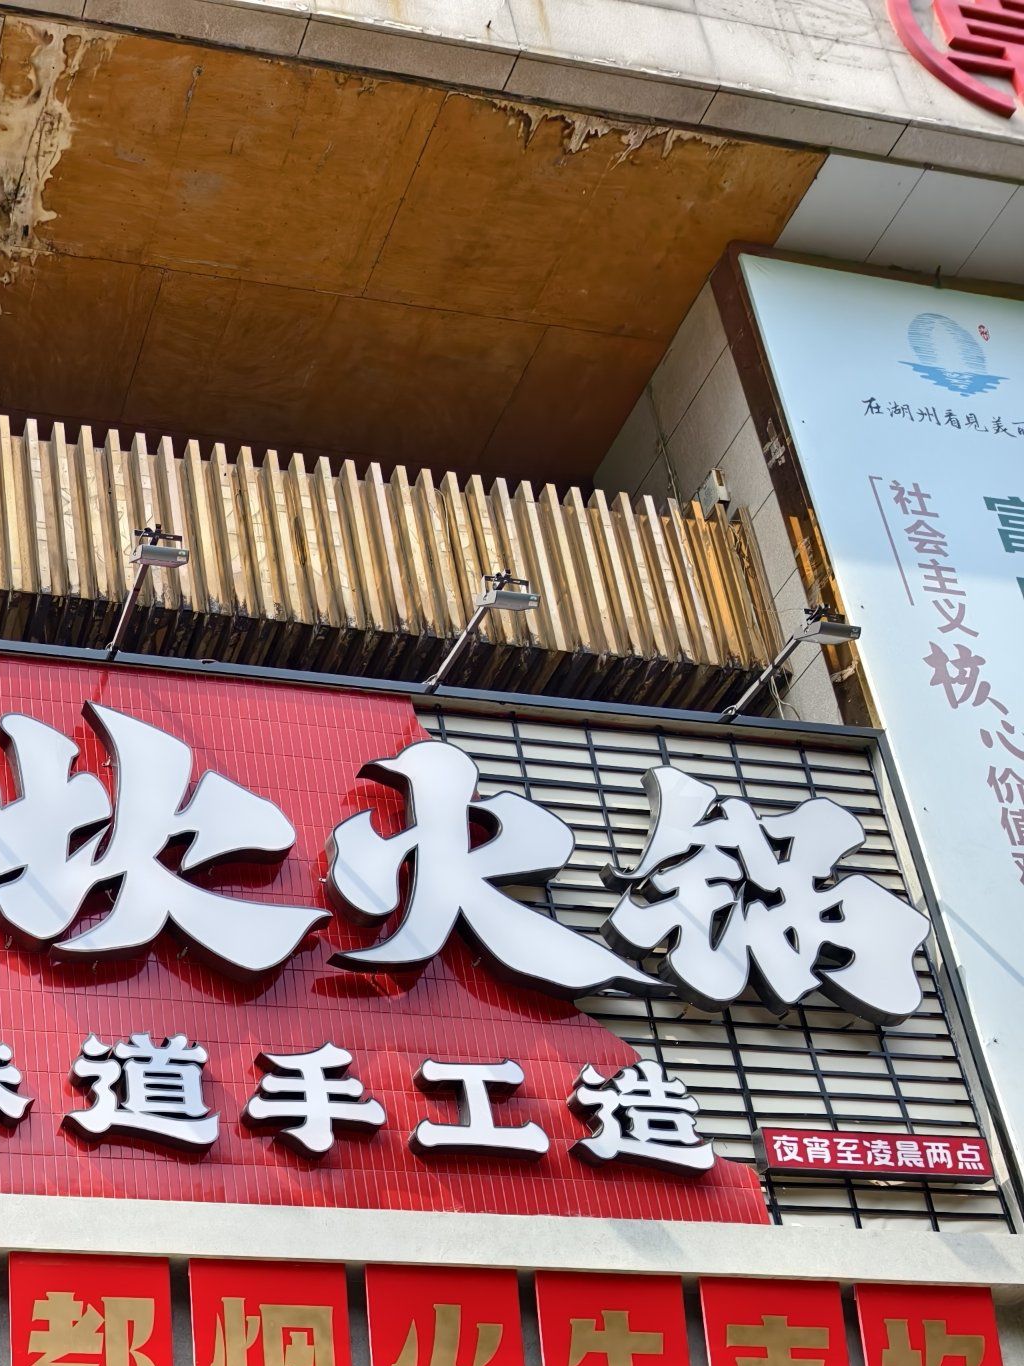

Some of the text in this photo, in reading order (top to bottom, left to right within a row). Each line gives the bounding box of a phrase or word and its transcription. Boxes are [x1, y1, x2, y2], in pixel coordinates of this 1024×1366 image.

[772, 1135, 985, 1171] 夜宵至凌晨两点
